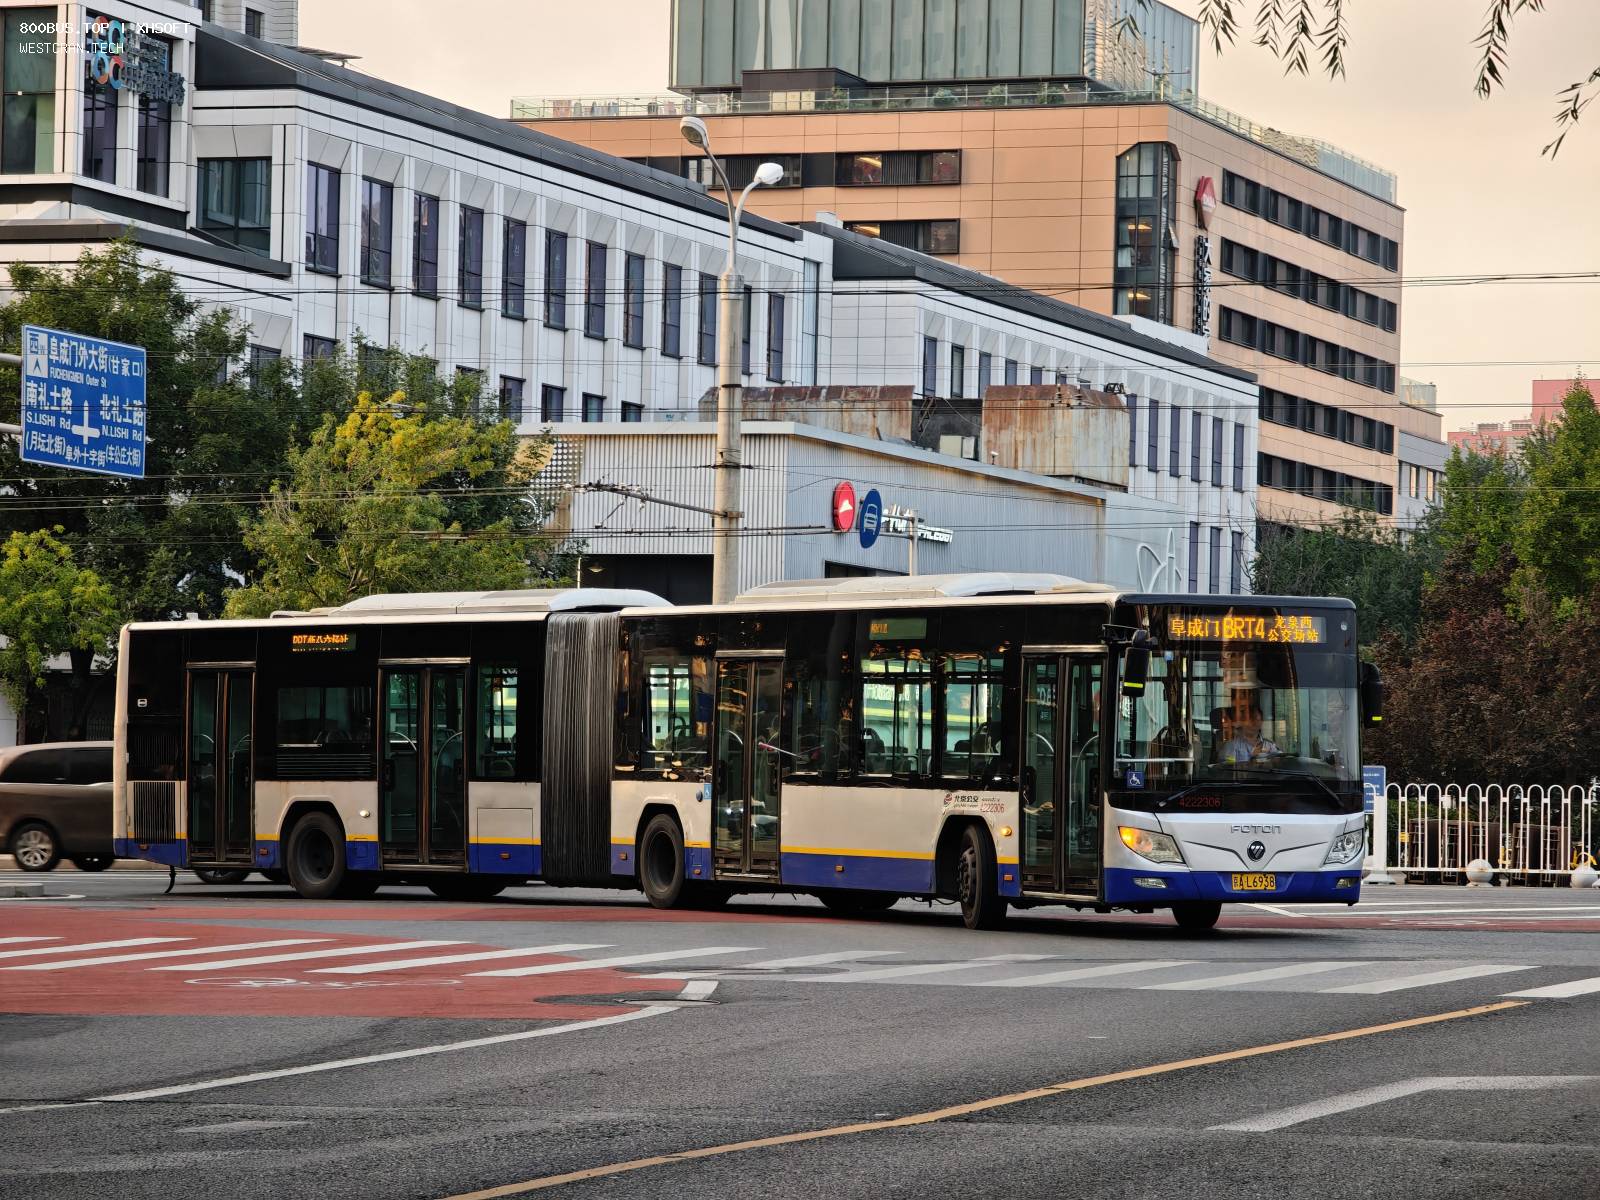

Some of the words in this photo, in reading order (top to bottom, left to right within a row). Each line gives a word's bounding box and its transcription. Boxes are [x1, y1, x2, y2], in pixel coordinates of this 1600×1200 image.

[26, 411, 56, 428] S.LISHI
[59, 418, 71, 430] Rd
[101, 424, 129, 440] N.LISHI
[132, 430, 142, 442] Rd
[1171, 618, 1220, 638] 阜成门
[1223, 616, 1265, 639] BRT4
[1230, 824, 1281, 834] FOTON
